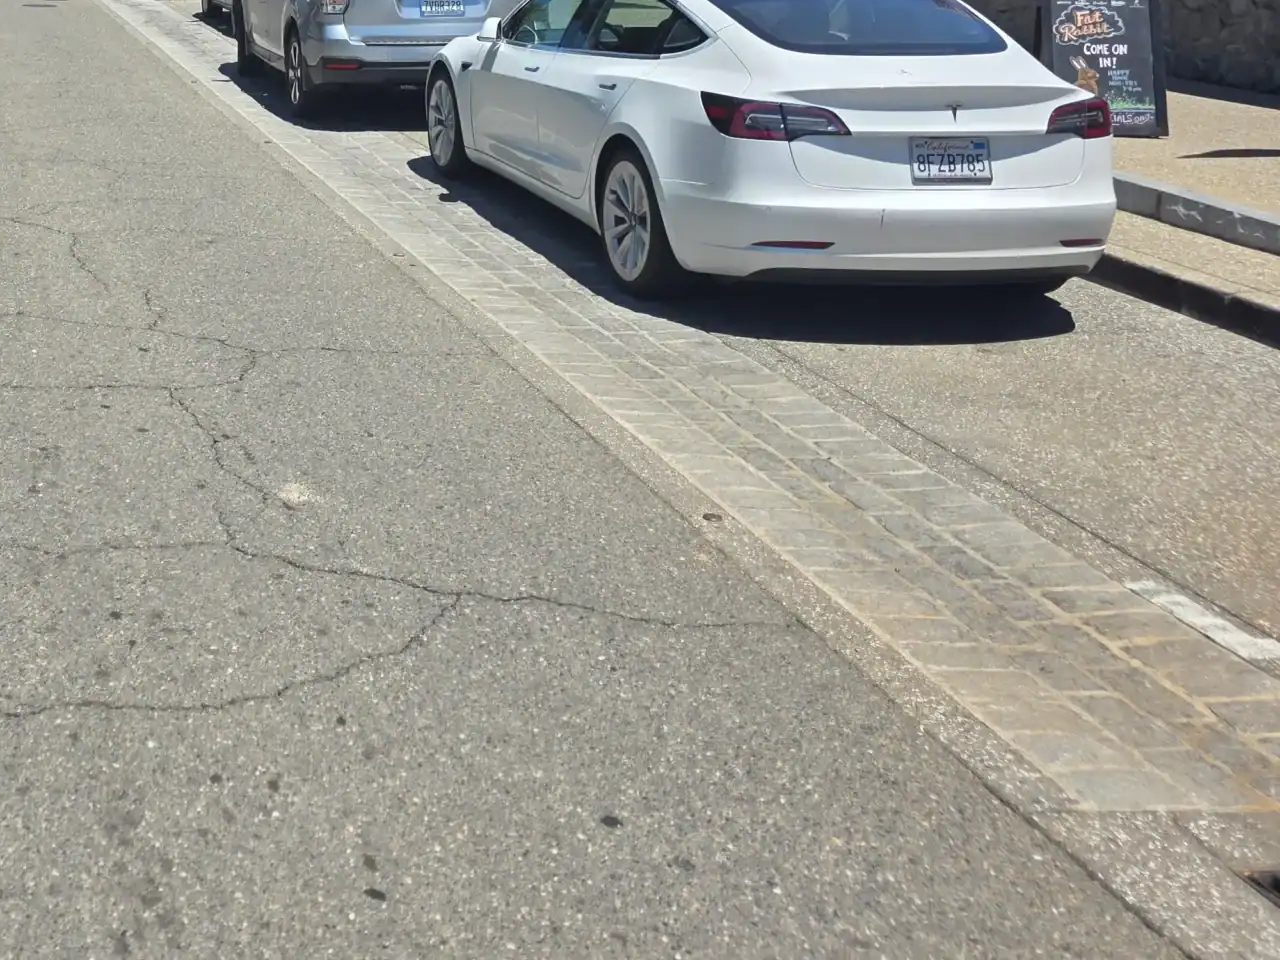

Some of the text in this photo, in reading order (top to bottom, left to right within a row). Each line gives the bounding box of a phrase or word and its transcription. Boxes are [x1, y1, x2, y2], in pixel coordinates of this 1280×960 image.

[1073, 11, 1104, 27] Fat
[1083, 43, 1128, 55] COME ON
[1099, 57, 1117, 69] IN!
[916, 153, 985, 172] 8FZB785
